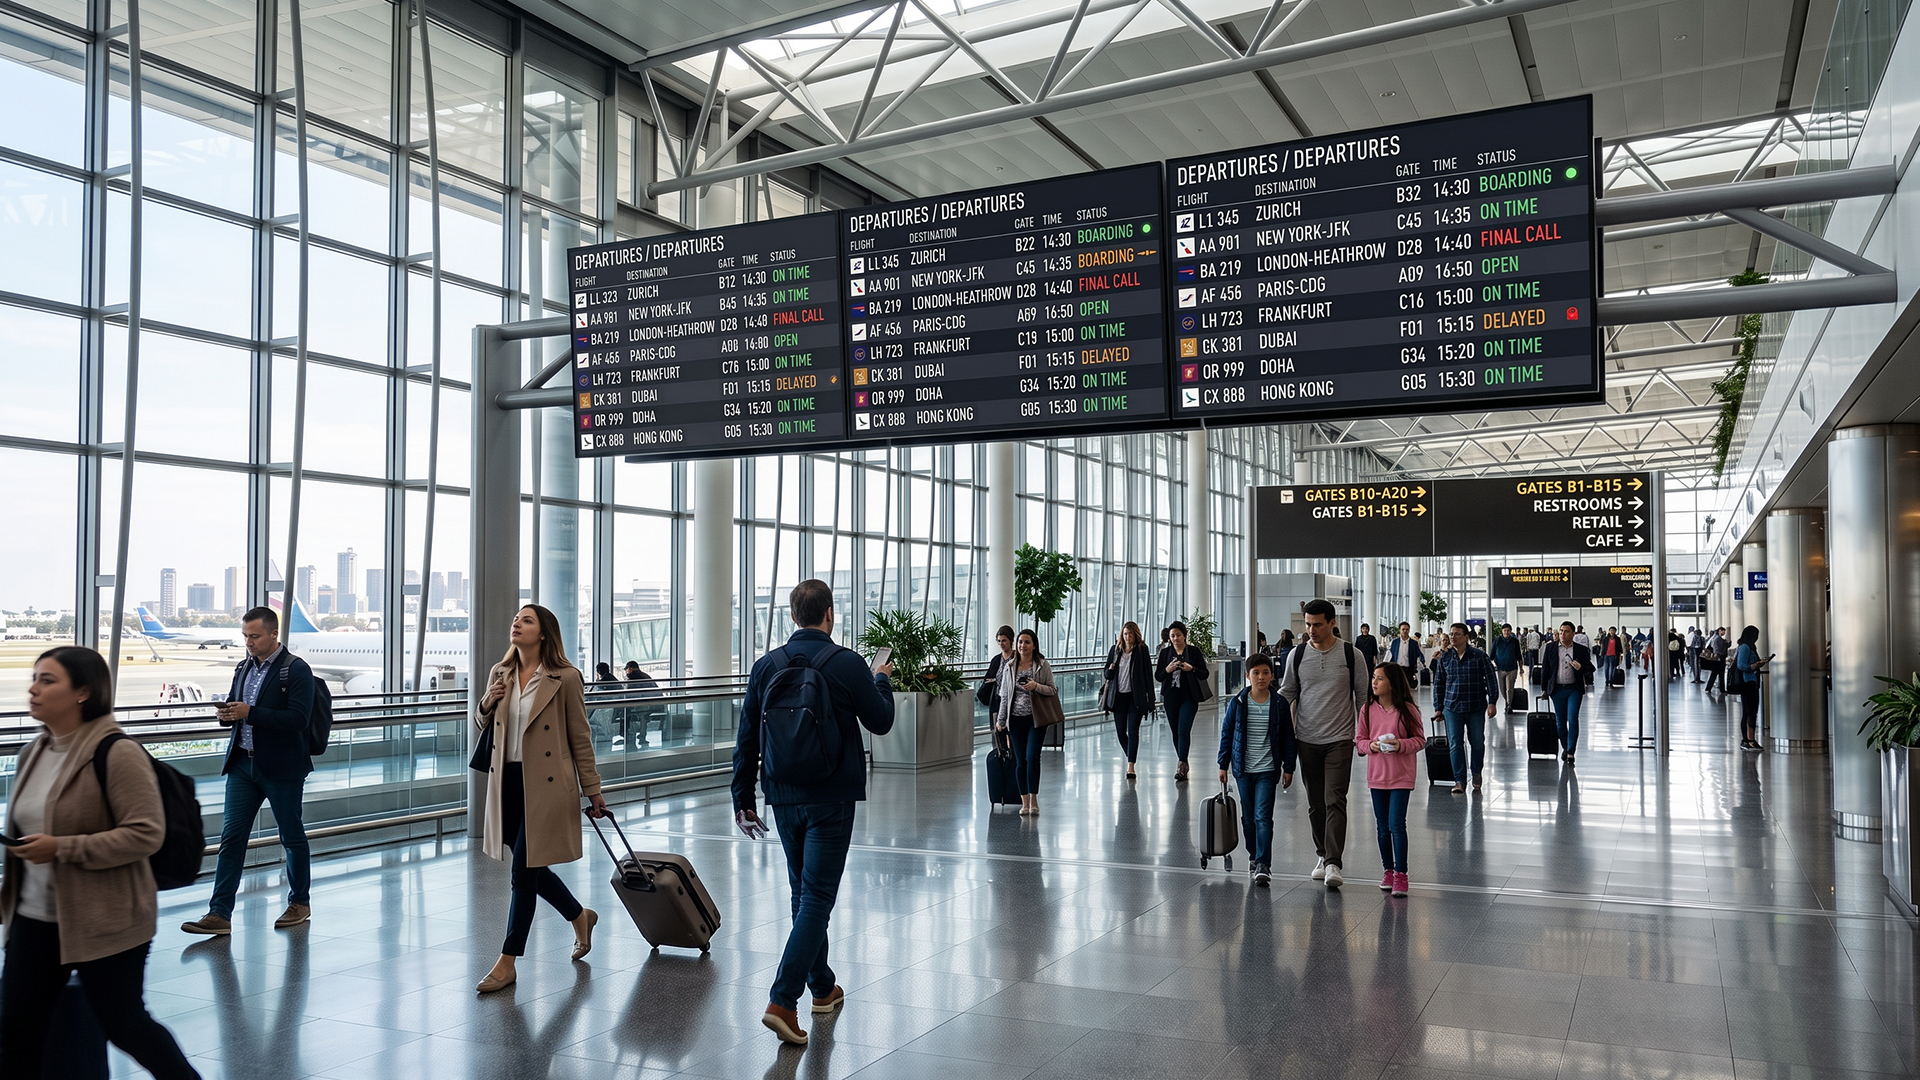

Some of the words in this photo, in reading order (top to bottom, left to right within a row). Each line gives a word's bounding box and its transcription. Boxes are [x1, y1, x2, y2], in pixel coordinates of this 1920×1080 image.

[1177, 192, 1208, 207] FLIGHT
[1255, 177, 1316, 197] DESTINATION
[1396, 162, 1420, 177] GATE
[1433, 157, 1457, 171] TIME
[1477, 149, 1516, 165] STATUS
[1178, 153, 1278, 186] DEPARTURES
[1294, 135, 1400, 169] DEPARTURES
[850, 206, 929, 233] DEPARTURES
[941, 192, 1024, 220] DEPARTURES
[1217, 209, 1239, 226] 345
[1255, 199, 1301, 221] ZURICH
[1397, 185, 1421, 203] B32
[1433, 178, 1470, 198] 14:30
[1480, 168, 1551, 192] BOARDING
[850, 238, 875, 251] FLIGHT
[909, 227, 957, 243] DESTINATION
[1015, 216, 1034, 229] GATE
[1042, 213, 1062, 225] TIME
[1076, 207, 1108, 222] STATUS
[1199, 238, 1216, 254] AA
[1219, 234, 1239, 251] 901
[1257, 228, 1285, 247] NEW
[1288, 220, 1350, 242] YORK-JFK
[1397, 212, 1422, 230] C45
[1434, 206, 1471, 225] 14:35
[1480, 202, 1499, 220] ON
[1504, 197, 1538, 217] TIME
[575, 247, 643, 270] DEPARTURES
[653, 235, 724, 260] DEPARTURES
[868, 257, 880, 271] LL
[882, 254, 899, 269] 345
[911, 248, 946, 265] ZURICH
[1015, 236, 1035, 252] B22
[1043, 232, 1071, 248] 14:30
[1077, 223, 1133, 244] BOARDING
[1200, 263, 1217, 278] BA
[1220, 259, 1241, 276] 219
[1257, 242, 1386, 272] LONDON-HEATHROW
[1398, 239, 1422, 256] D28
[1434, 233, 1471, 252] 14:40
[1481, 227, 1521, 247] FINAL
[1526, 223, 1561, 242] CALL
[575, 276, 596, 287] FLIGHT
[626, 266, 668, 281] DESTINATION
[718, 257, 735, 269] GATE
[742, 254, 758, 265] TIME
[770, 249, 796, 262] STATUS
[590, 293, 601, 305] LL
[602, 290, 618, 304] 323
[627, 285, 659, 300] ZURICH
[719, 275, 736, 289] B12
[742, 271, 766, 286] 14:30
[773, 269, 785, 282] ON
[788, 265, 810, 280] TIME
[869, 279, 882, 293] AA
[884, 278, 900, 291] 901
[912, 272, 934, 287] NEW
[936, 266, 985, 285] YORK-JFK
[1016, 260, 1035, 276] C45
[1043, 256, 1072, 272] 14:35
[1078, 248, 1134, 268] BOARDING
[1201, 287, 1216, 304] AF
[1220, 285, 1242, 301] 456
[1258, 276, 1325, 298] PARIS-CDG
[1398, 265, 1423, 283] A09
[1435, 260, 1472, 279] 16:50
[1482, 255, 1519, 275] OPEN
[590, 313, 602, 325] AA
[628, 306, 648, 321] NEW
[719, 296, 737, 311] B45
[743, 292, 767, 307] 14:35
[773, 290, 786, 304] ON
[788, 287, 809, 302] TIME
[869, 301, 882, 315] BA
[884, 299, 901, 313] 219
[912, 286, 1012, 310] LONDON-HEATHROW
[1017, 283, 1036, 298] D28
[1044, 279, 1072, 295] 14:40
[1079, 275, 1110, 292] FINAL
[1113, 272, 1140, 288] CALL
[1202, 313, 1217, 328] LH
[1221, 310, 1243, 326] 723
[1259, 301, 1332, 323] FRANKFURT
[1400, 292, 1424, 310] C16
[1436, 287, 1473, 306] 15:00
[1483, 285, 1501, 302] ON
[1506, 281, 1540, 299] TIME
[591, 333, 603, 345] BA
[604, 331, 619, 344] 219
[629, 320, 715, 342] LONDON-HEATHROW
[720, 317, 738, 332] D28
[773, 311, 799, 325] FINAL
[802, 308, 824, 322] CALL
[870, 323, 882, 338] AF
[885, 322, 902, 336] 456
[913, 314, 966, 333] PARIS-CDG
[1045, 304, 1073, 319] 16:50
[1080, 300, 1109, 316] OPEN
[1222, 336, 1242, 352] 381
[1259, 331, 1297, 349] DUBAI
[1400, 320, 1422, 337] F01
[1437, 315, 1474, 333] 15:15
[1484, 309, 1545, 329] DELAYED
[593, 373, 604, 386] LH
[606, 371, 621, 385] 723
[631, 366, 680, 382] FRANKFURT
[746, 357, 769, 371] 15:00
[775, 356, 787, 369] ON
[790, 353, 812, 367] TIME
[871, 368, 884, 382] CK
[886, 367, 902, 381] 381
[915, 363, 944, 379] DUBAI
[1019, 354, 1036, 369] F01
[1046, 351, 1075, 367] 15:15
[1082, 347, 1129, 364] DELAYED
[594, 393, 605, 406] CK
[607, 392, 621, 405] 381
[632, 389, 658, 403] DUBAI
[723, 382, 738, 395] F01
[747, 379, 771, 393] 15:15
[776, 375, 816, 390] DELAYED
[1204, 388, 1219, 404] CX
[1223, 387, 1245, 403] 888
[1261, 383, 1295, 400] HONG
[1299, 380, 1334, 398] KONG
[1401, 373, 1426, 390] G05
[1438, 370, 1475, 388] 15:30
[1485, 368, 1504, 385] ON
[1508, 365, 1543, 383] TIME
[596, 435, 607, 448] CX
[609, 433, 624, 447] 888
[633, 431, 657, 445] HONG
[659, 429, 683, 443] KONG
[724, 424, 742, 438] G05
[749, 423, 773, 436] 15:30
[778, 421, 791, 434] ON
[793, 419, 816, 433] TIME
[1305, 488, 1346, 501] GATES
[1350, 486, 1408, 500] B10-A20
[1517, 481, 1563, 495] GATES
[1568, 478, 1622, 493] B1-B15
[1534, 497, 1622, 512] RESTROOMS
[1312, 506, 1353, 519] GATES
[1358, 504, 1408, 517] B1-B15
[1573, 515, 1623, 529] RETAIL
[1586, 534, 1623, 547] CAFE
